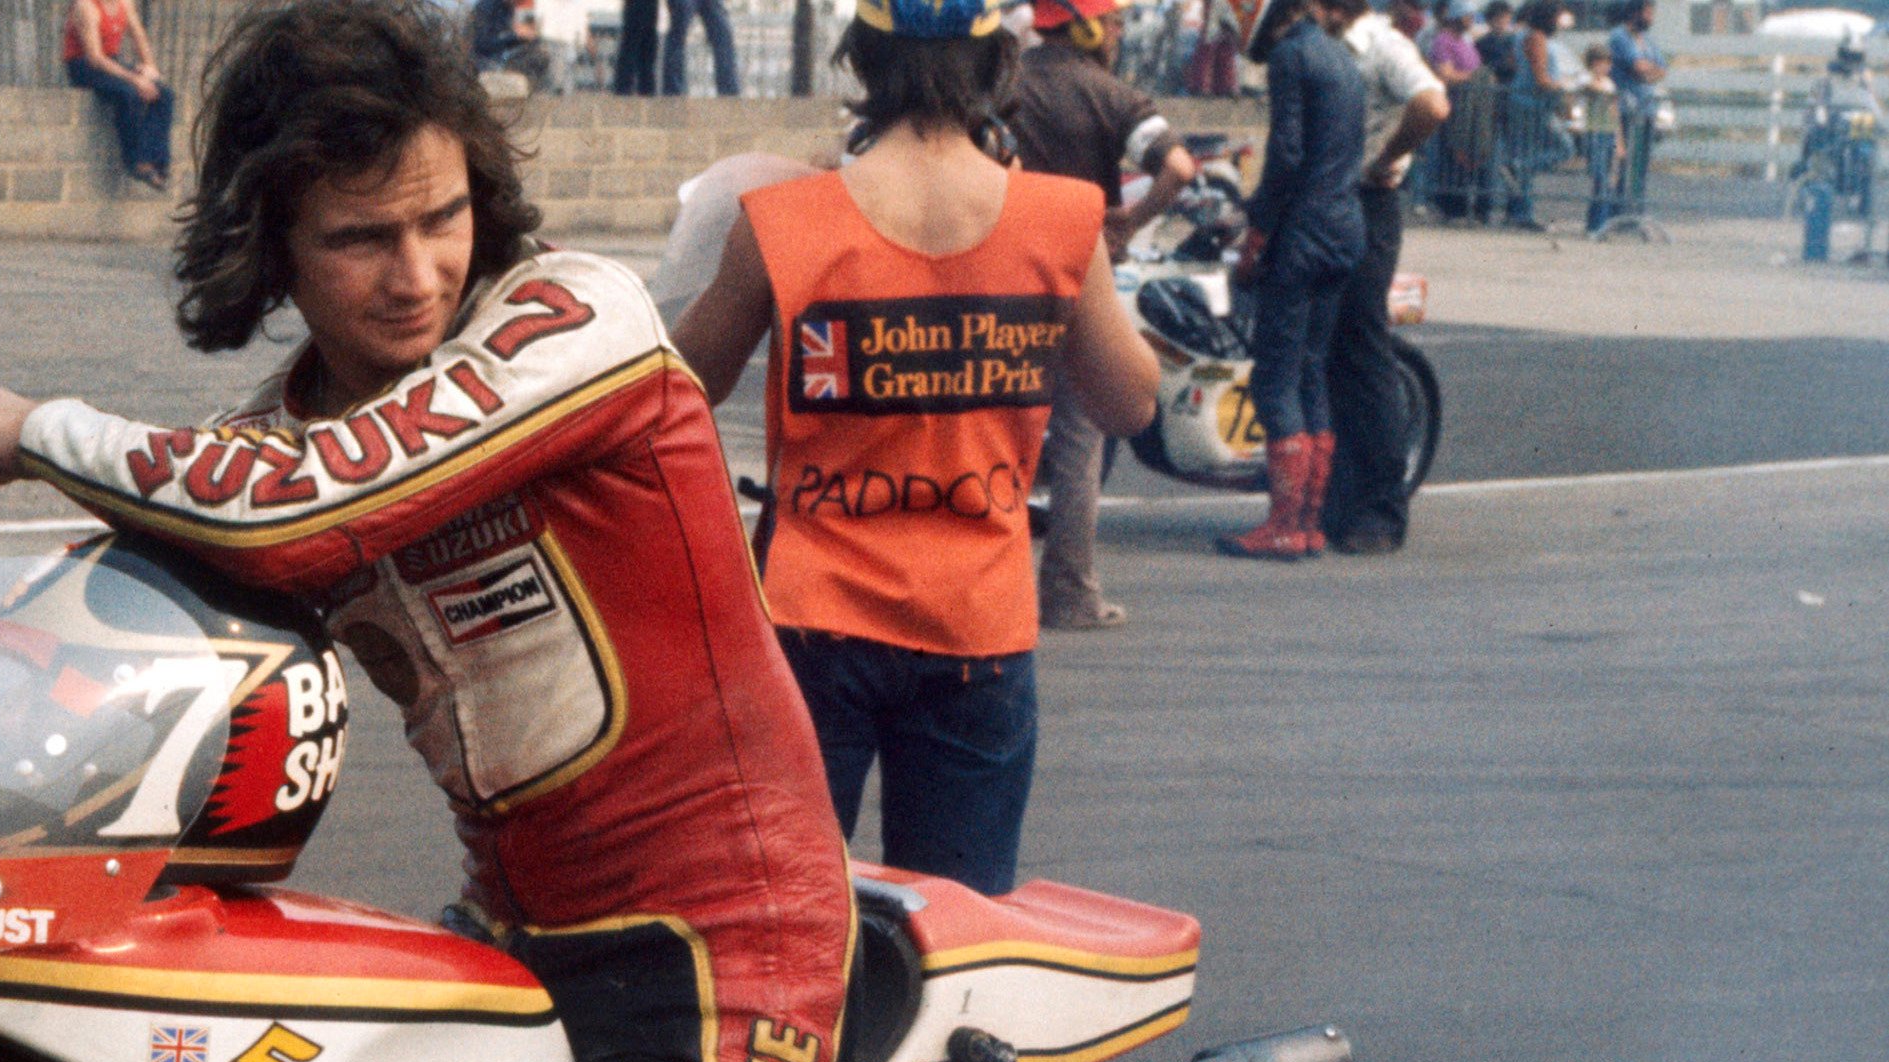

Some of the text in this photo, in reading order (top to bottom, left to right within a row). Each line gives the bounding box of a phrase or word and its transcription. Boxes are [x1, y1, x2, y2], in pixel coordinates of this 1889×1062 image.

[861, 311, 1067, 356] John Player
[126, 279, 596, 508] SUZUKI 7
[863, 359, 1044, 398] Grand Prix
[792, 462, 1022, 518] PADDOC
[404, 504, 531, 572] SUZUKI
[443, 576, 542, 625] CHAMPION
[96, 656, 250, 837] 7
